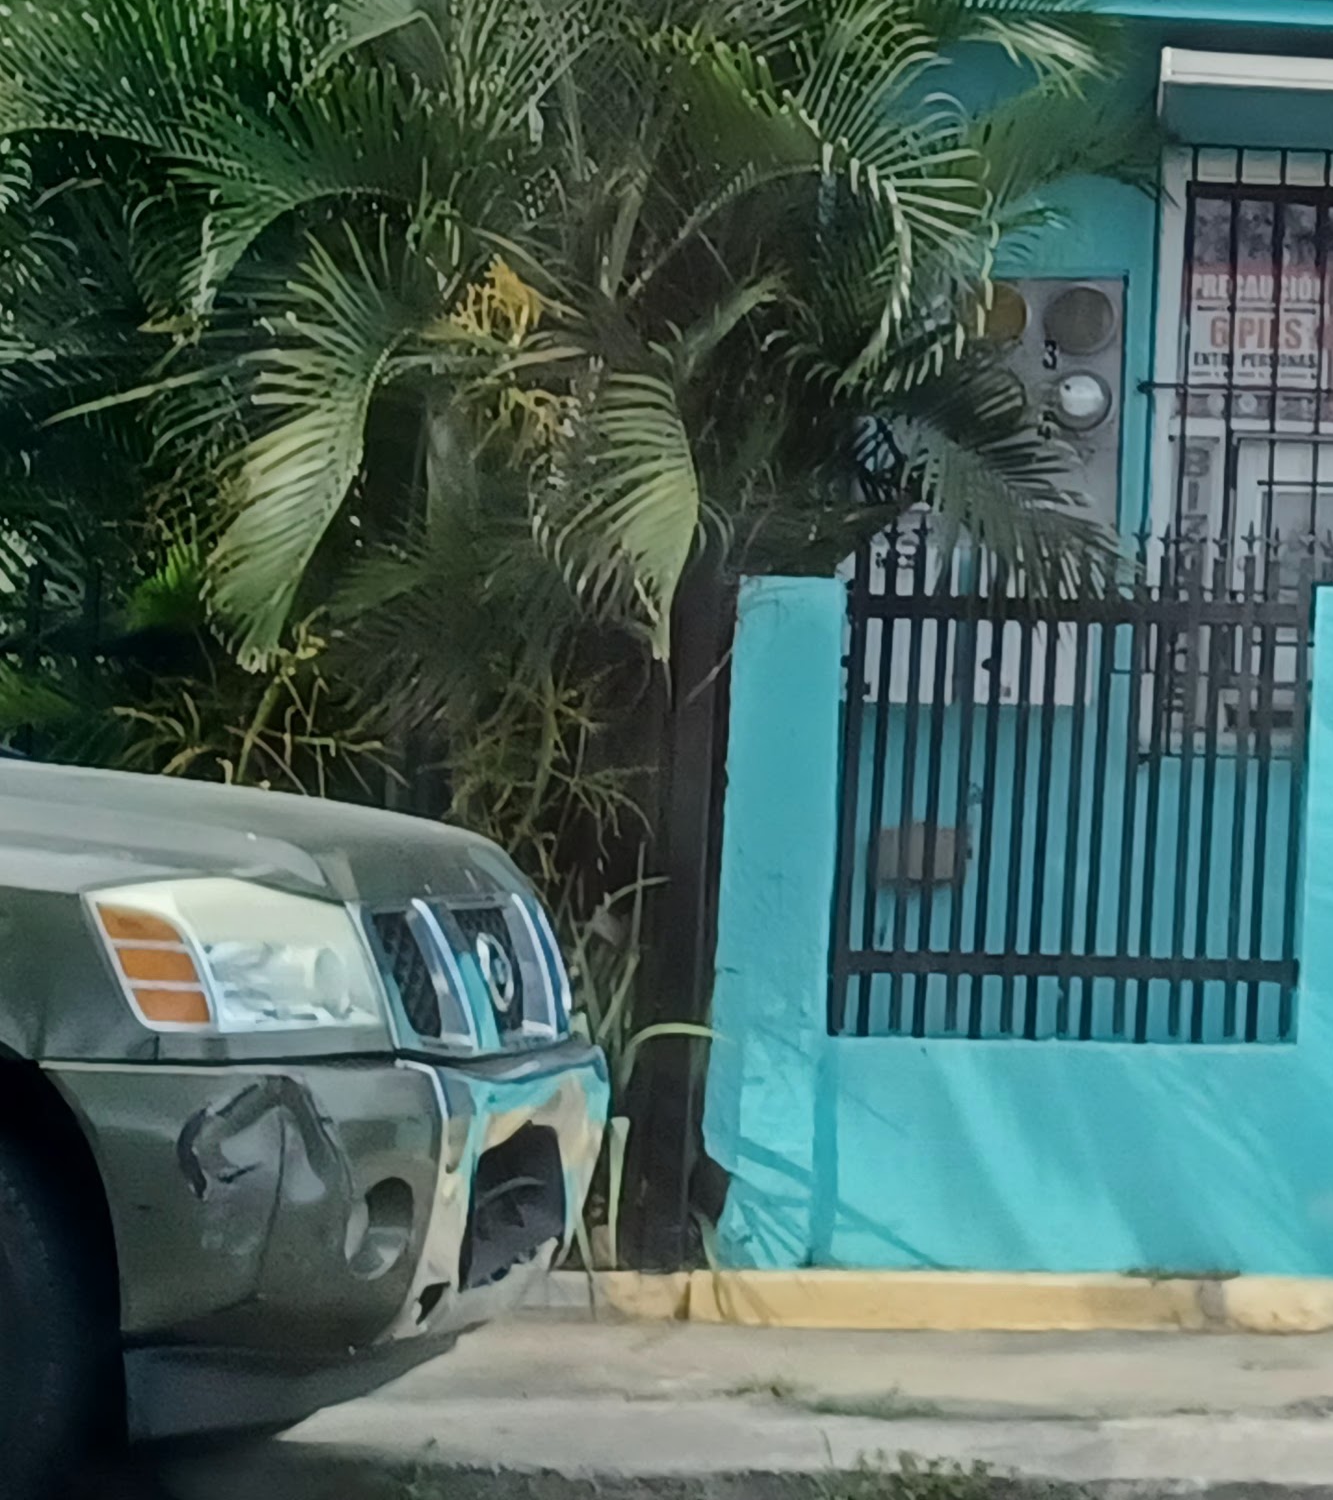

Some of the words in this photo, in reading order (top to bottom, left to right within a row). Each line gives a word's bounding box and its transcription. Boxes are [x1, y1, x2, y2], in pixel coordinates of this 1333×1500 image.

[1238, 317, 1302, 350] PIS
[1194, 352, 1232, 368] ENTR
[1241, 353, 1316, 369] PERONAS
